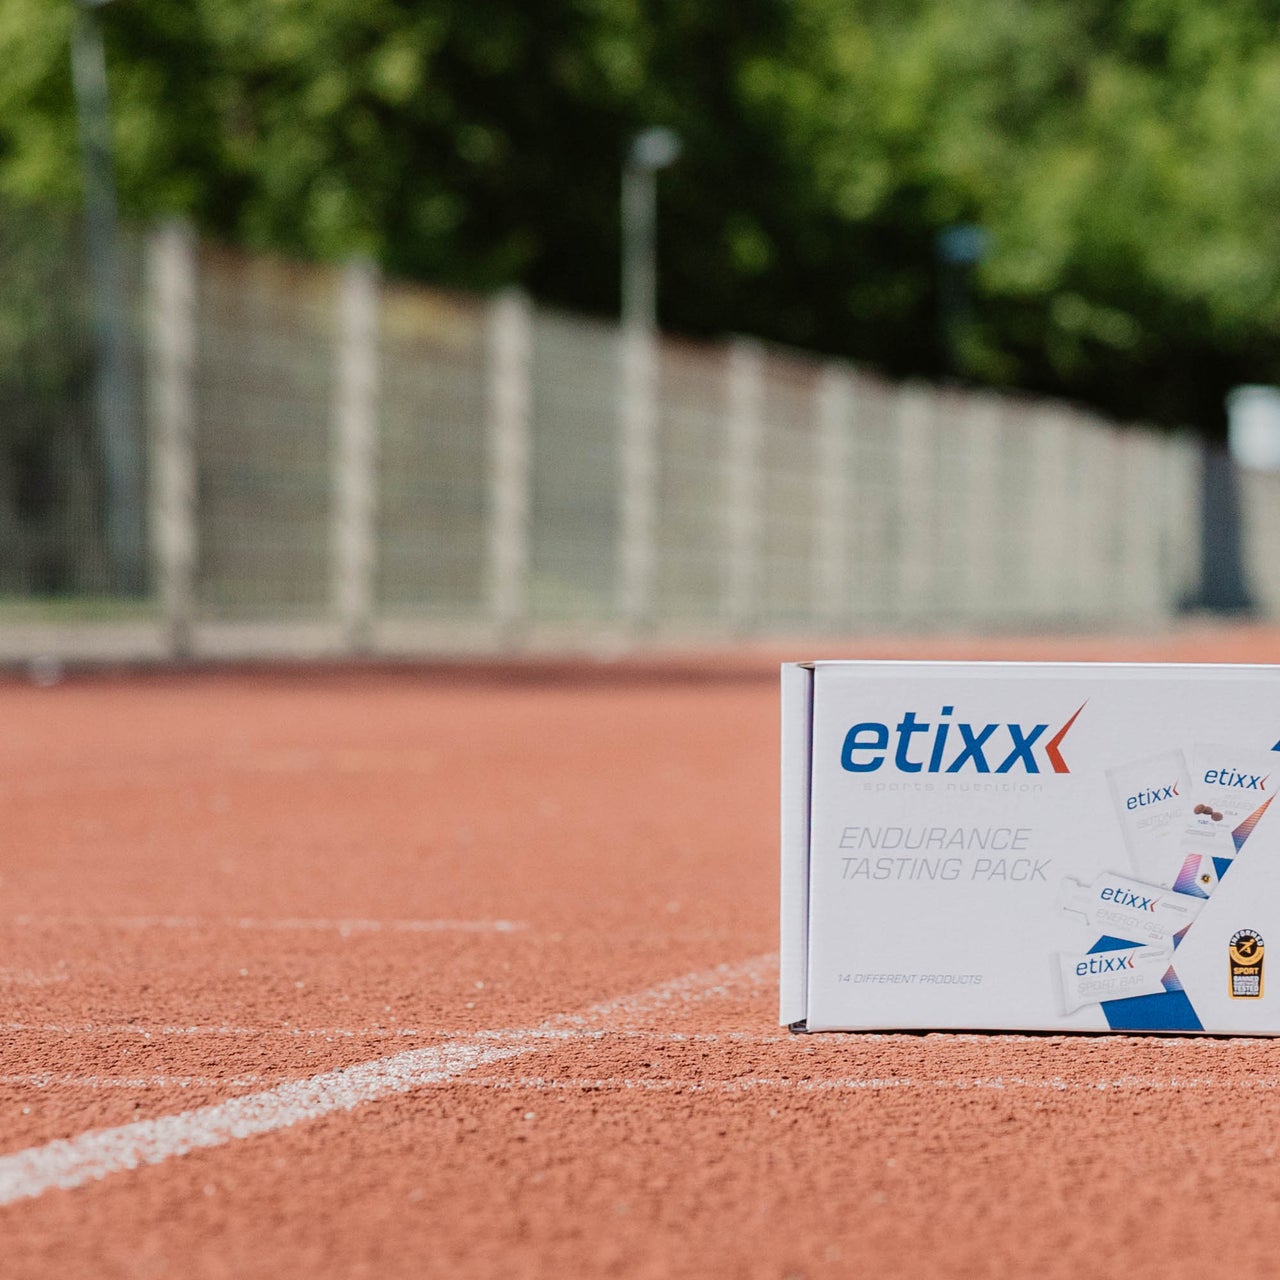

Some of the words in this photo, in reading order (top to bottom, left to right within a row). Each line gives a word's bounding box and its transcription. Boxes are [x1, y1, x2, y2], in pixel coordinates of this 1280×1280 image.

[840, 705, 1049, 774] etixx
[863, 782, 935, 793] sports
[946, 782, 1044, 793] nutrition
[1203, 768, 1261, 790] etixx
[1126, 785, 1173, 810] etixx
[838, 826, 1033, 851] ENDURANCE
[841, 857, 963, 881] TASTING
[971, 858, 1053, 882] PACK
[1100, 887, 1152, 911] etixx
[1076, 955, 1128, 976] etixx
[1233, 967, 1260, 975] SPORT
[837, 974, 851, 984] 14
[853, 974, 918, 984] DIFFERENT
[919, 974, 984, 985] PRODUCTS
[1078, 978, 1117, 993] SPORT
[1119, 974, 1145, 987] BAR
